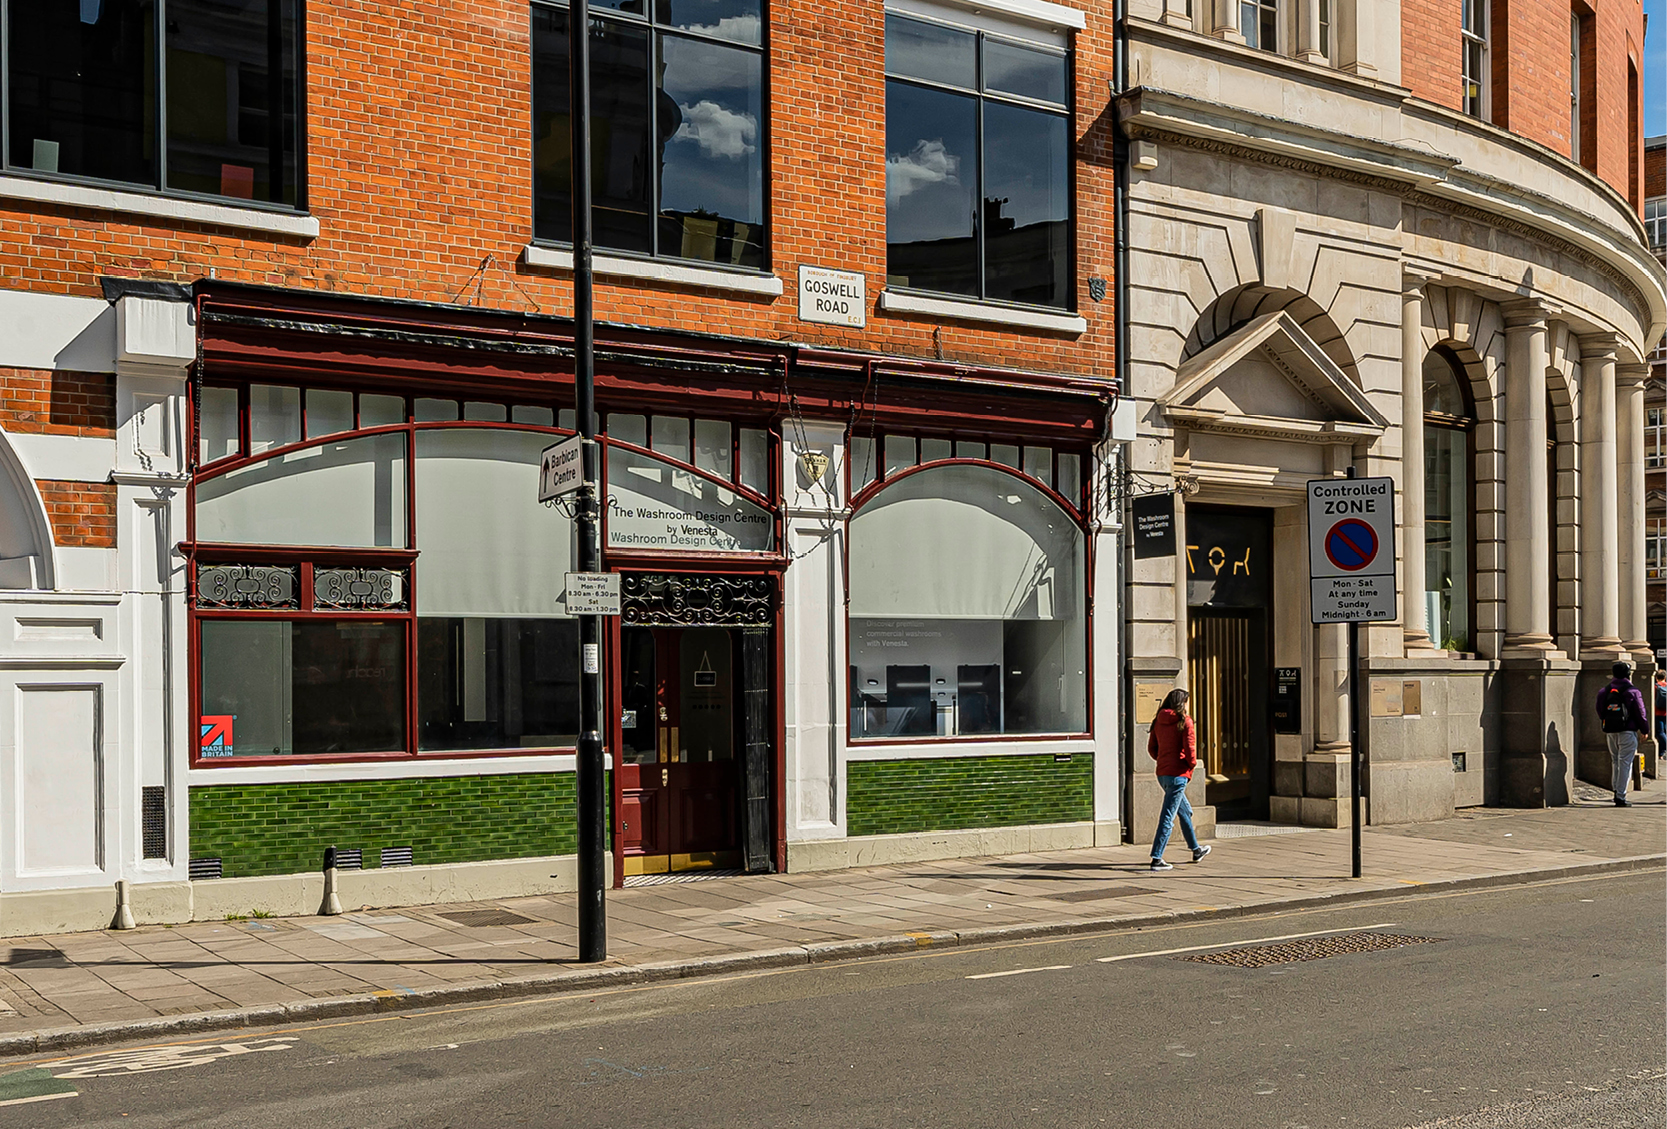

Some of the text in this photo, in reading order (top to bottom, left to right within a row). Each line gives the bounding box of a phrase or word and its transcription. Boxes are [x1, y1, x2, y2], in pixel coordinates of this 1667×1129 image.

[805, 279, 860, 299] GOSWELL
[816, 298, 849, 315] ROAD
[551, 448, 578, 469] Barbican
[553, 468, 576, 486] Centre
[1313, 483, 1386, 497] Controlled
[1324, 499, 1376, 515] ZONE
[613, 506, 767, 524] The Washroom Design Centre
[666, 524, 718, 536] by Venesta
[1333, 580, 1351, 588] Mon
[1358, 579, 1374, 587] Sat
[1328, 589, 1378, 599] At any time
[1337, 600, 1370, 609] Sunday
[1322, 610, 1360, 620] Midnight
[1366, 609, 1372, 617] 6
